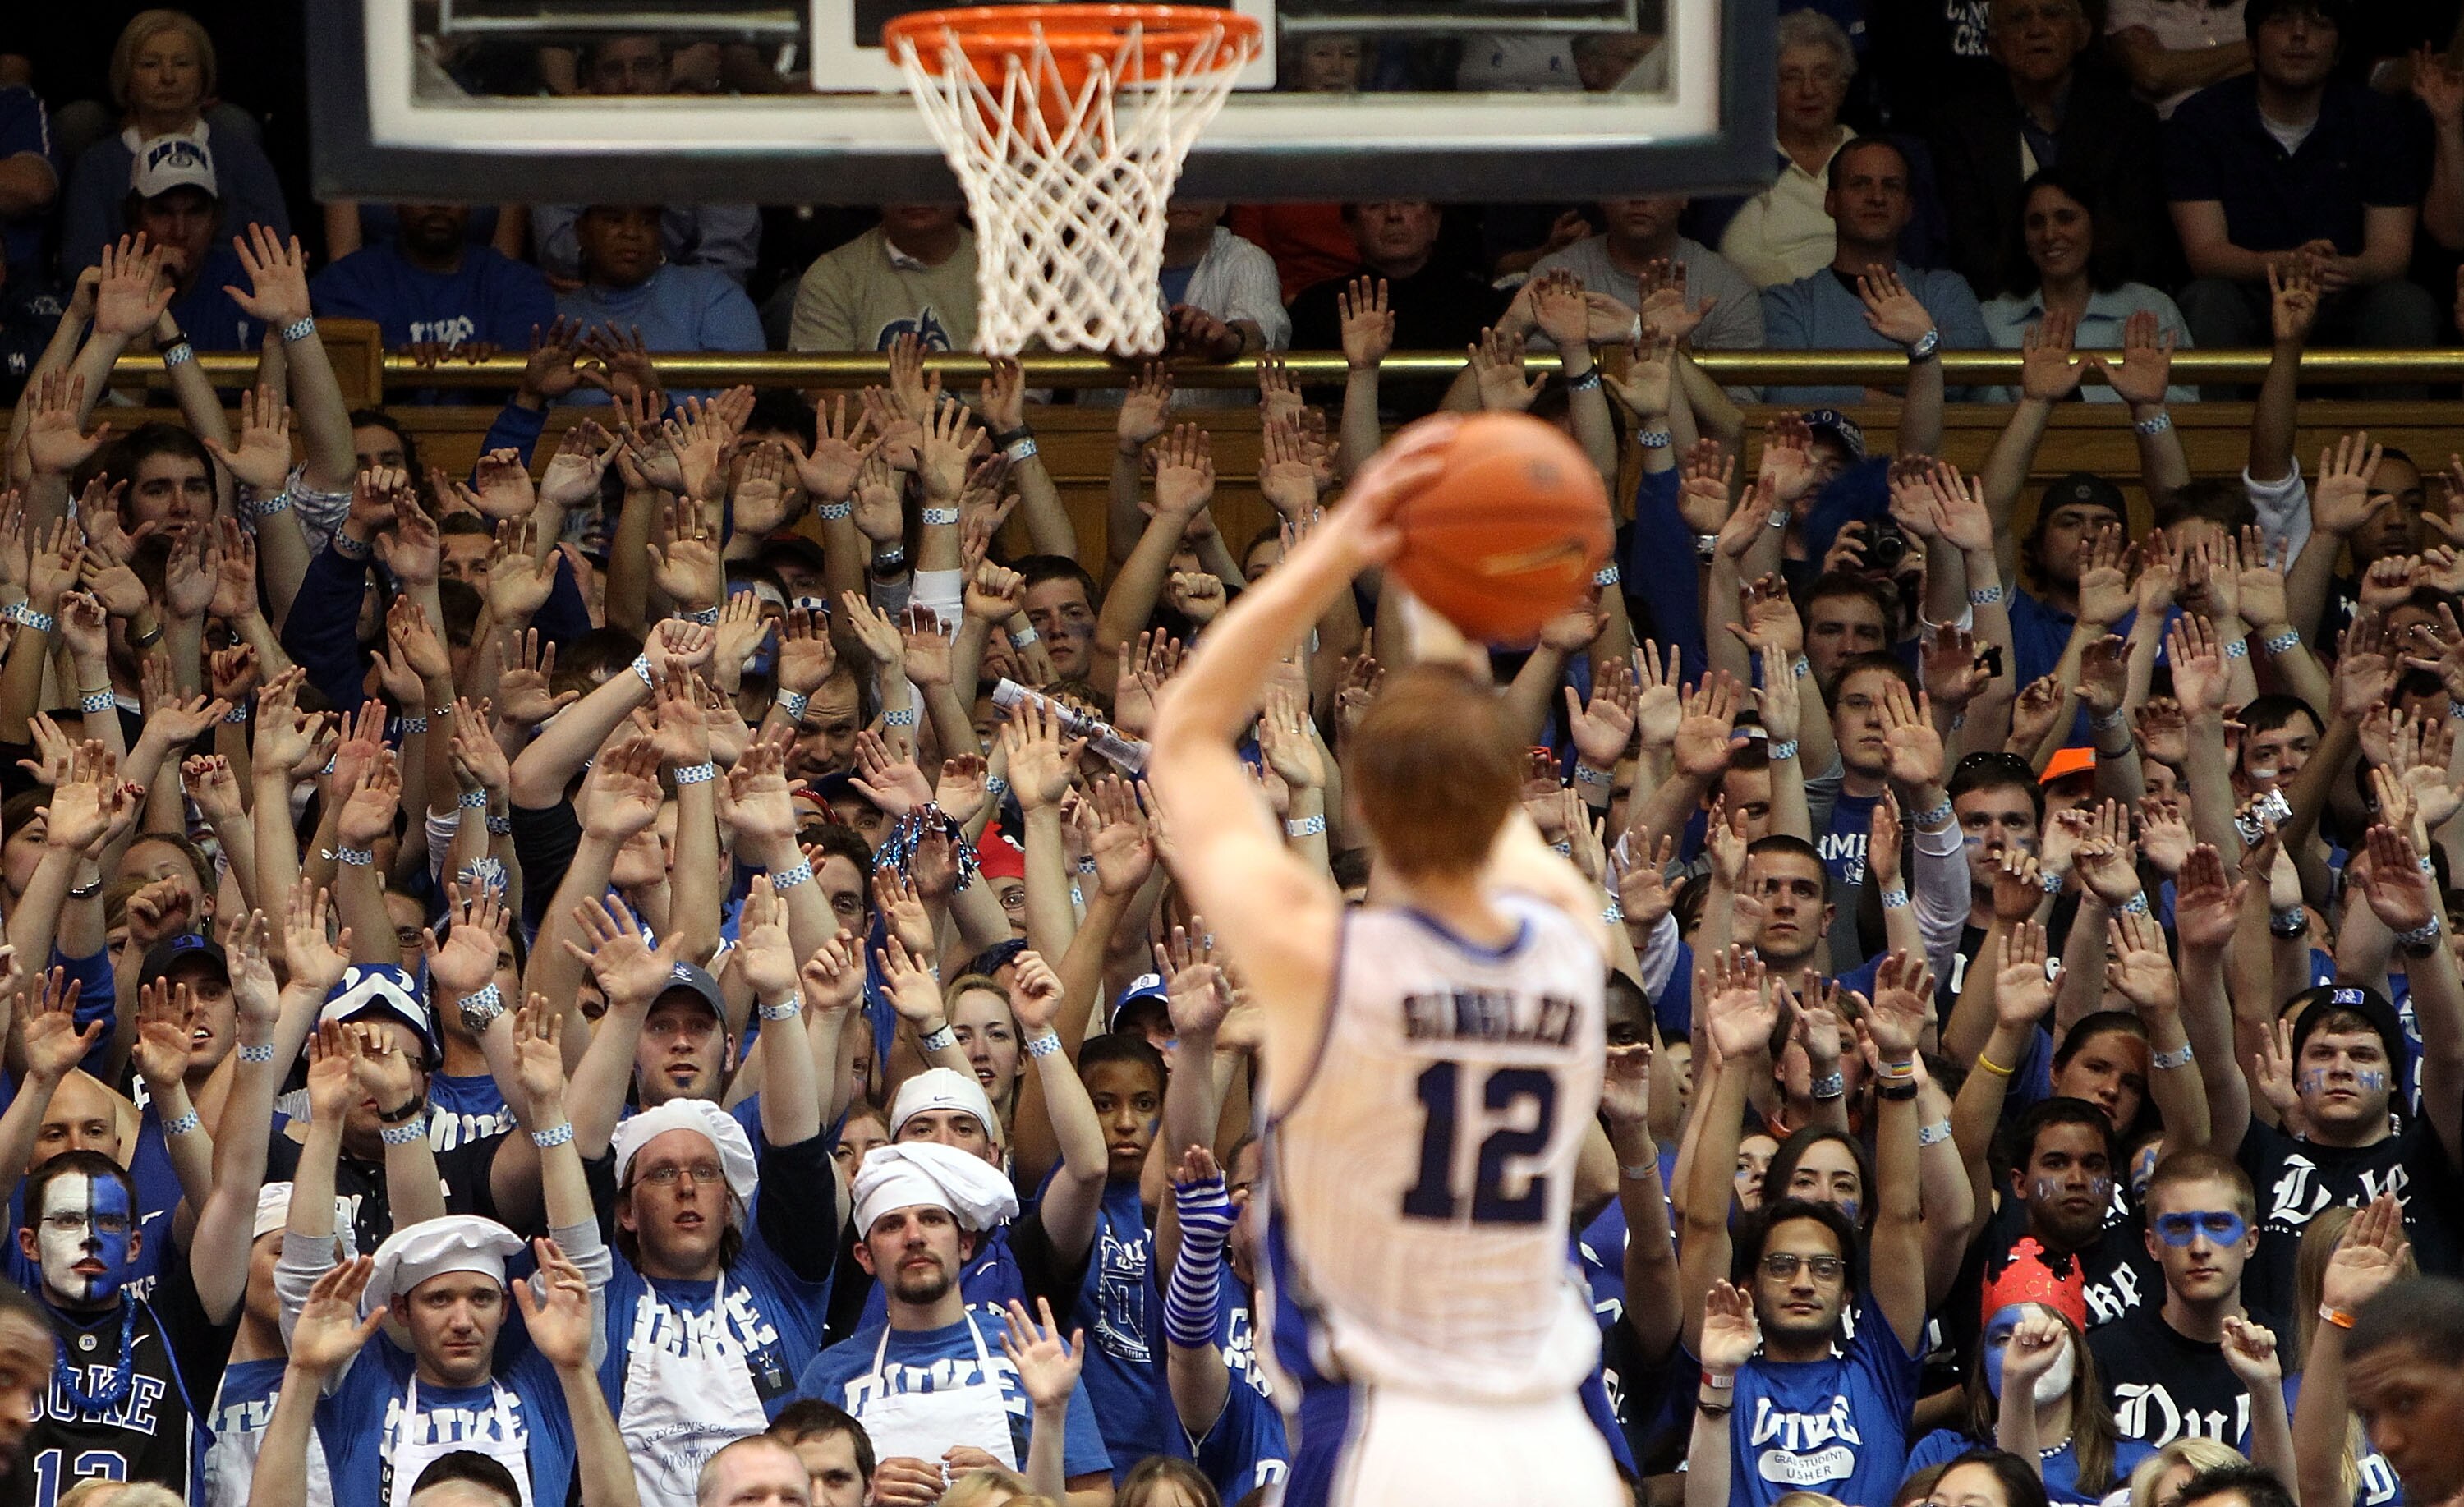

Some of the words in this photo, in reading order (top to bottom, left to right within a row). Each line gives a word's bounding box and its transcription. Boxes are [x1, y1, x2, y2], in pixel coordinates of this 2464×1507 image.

[1401, 1060, 1556, 1222] 12
[2269, 1154, 2412, 1224] Dke
[27, 1363, 166, 1436] UKE
[1751, 1395, 1863, 1451] DUKE
[1786, 1465, 1832, 1481] USHER
[1800, 1450, 1843, 1469] STUDENT
